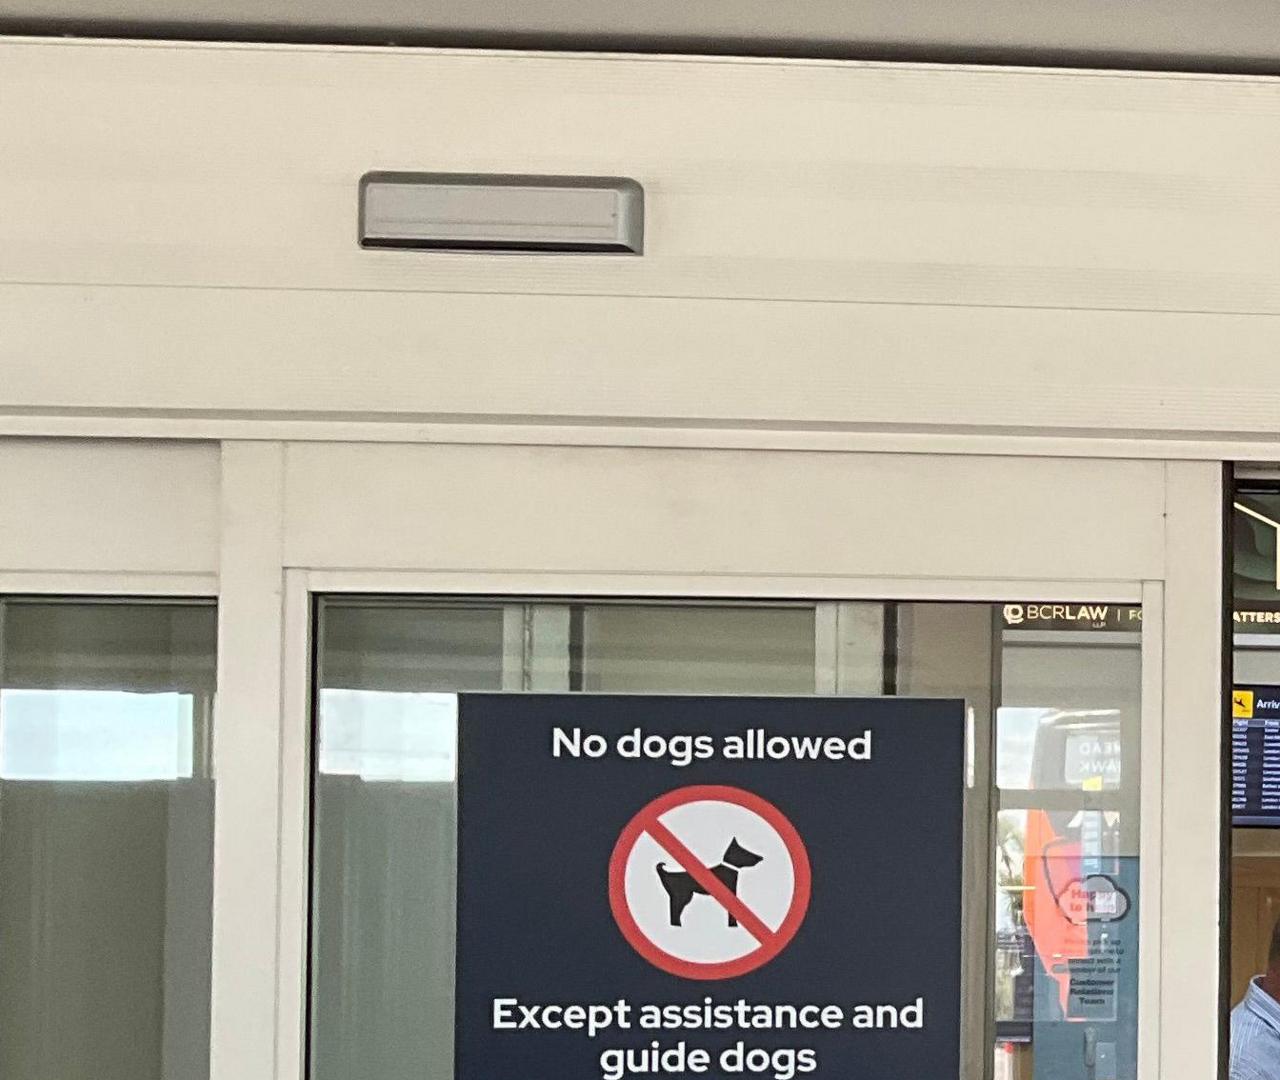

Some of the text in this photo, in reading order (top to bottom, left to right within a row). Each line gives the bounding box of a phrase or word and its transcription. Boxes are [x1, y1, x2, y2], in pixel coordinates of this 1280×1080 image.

[1026, 605, 1109, 621] BCRLAW
[551, 726, 872, 767] No dogs allowed
[492, 996, 924, 1037] Except assistance and
[599, 1041, 817, 1080] guide dogs
